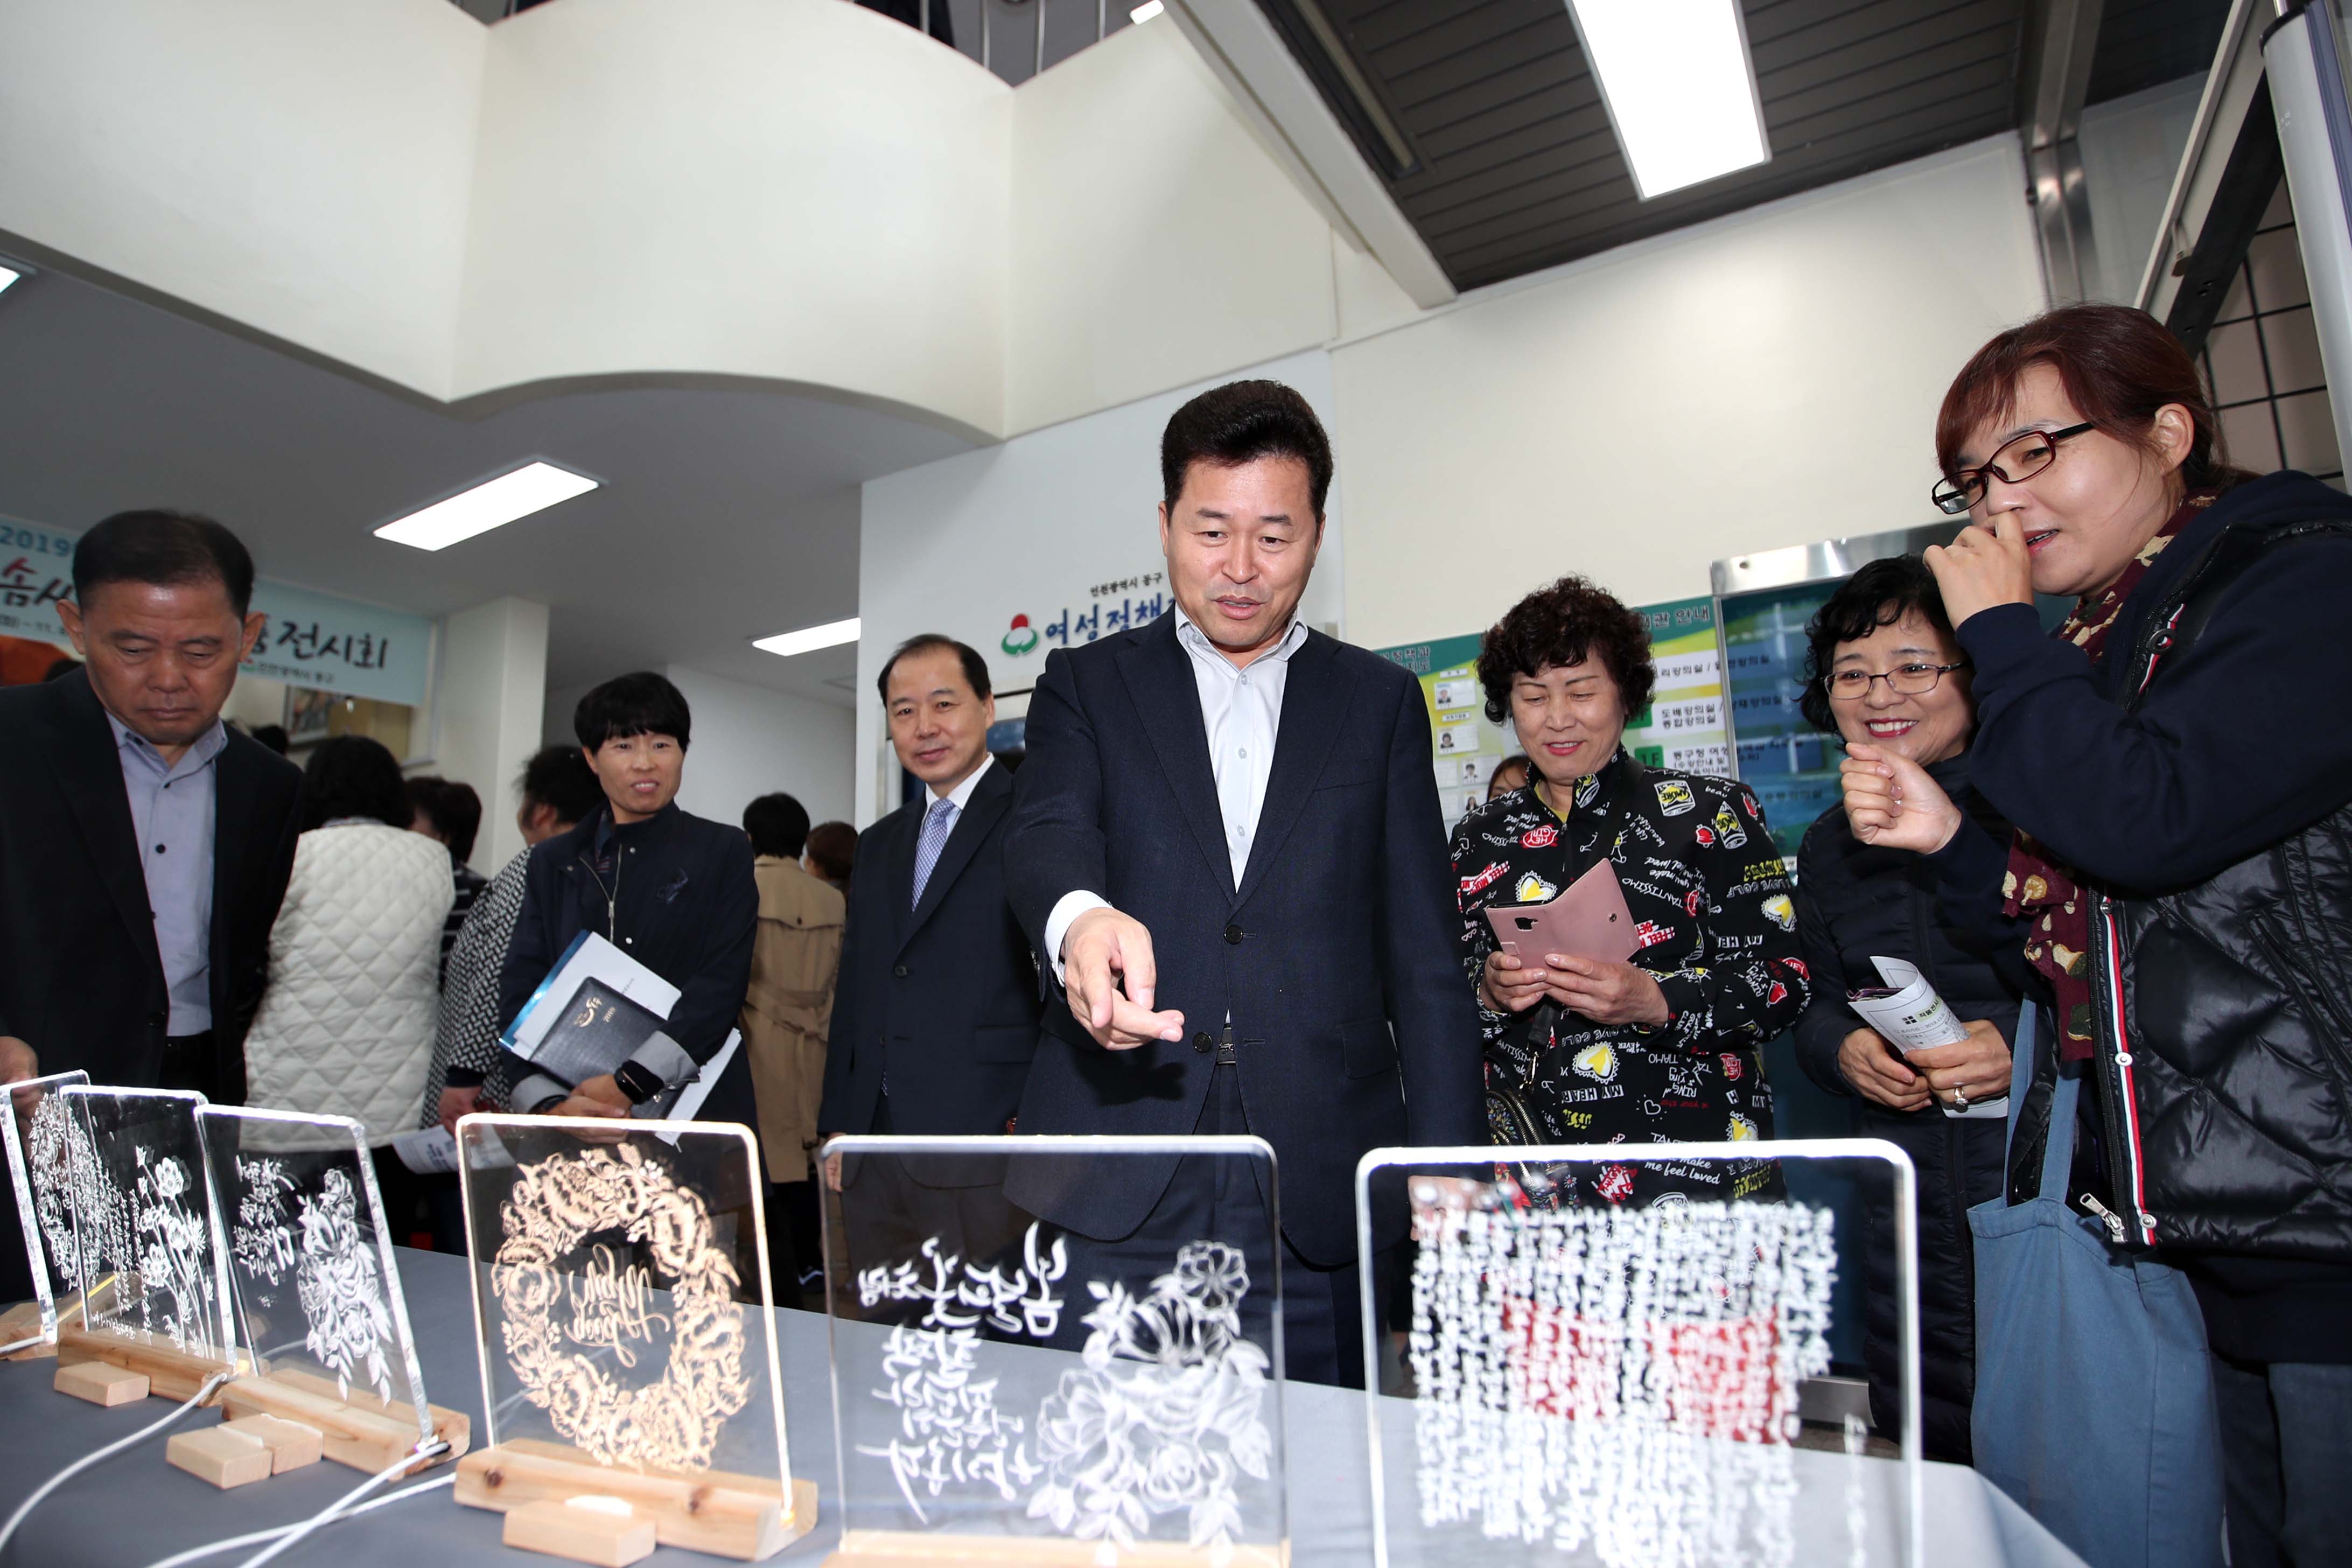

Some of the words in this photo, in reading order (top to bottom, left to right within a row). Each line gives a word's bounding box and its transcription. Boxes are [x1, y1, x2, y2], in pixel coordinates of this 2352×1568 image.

[1090, 576, 1138, 597] 인천광역시
[1675, 605, 1710, 626] 안내
[276, 621, 389, 669] 전시회
[1644, 856, 1671, 870] loved
[1649, 869, 1675, 880] make
[1621, 877, 1684, 909] TANTISSIMO
[1601, 1084, 1625, 1099] MY
[1644, 1160, 1663, 1172] me
[1663, 1162, 1688, 1178] feel
[1688, 1166, 1721, 1186] loved
